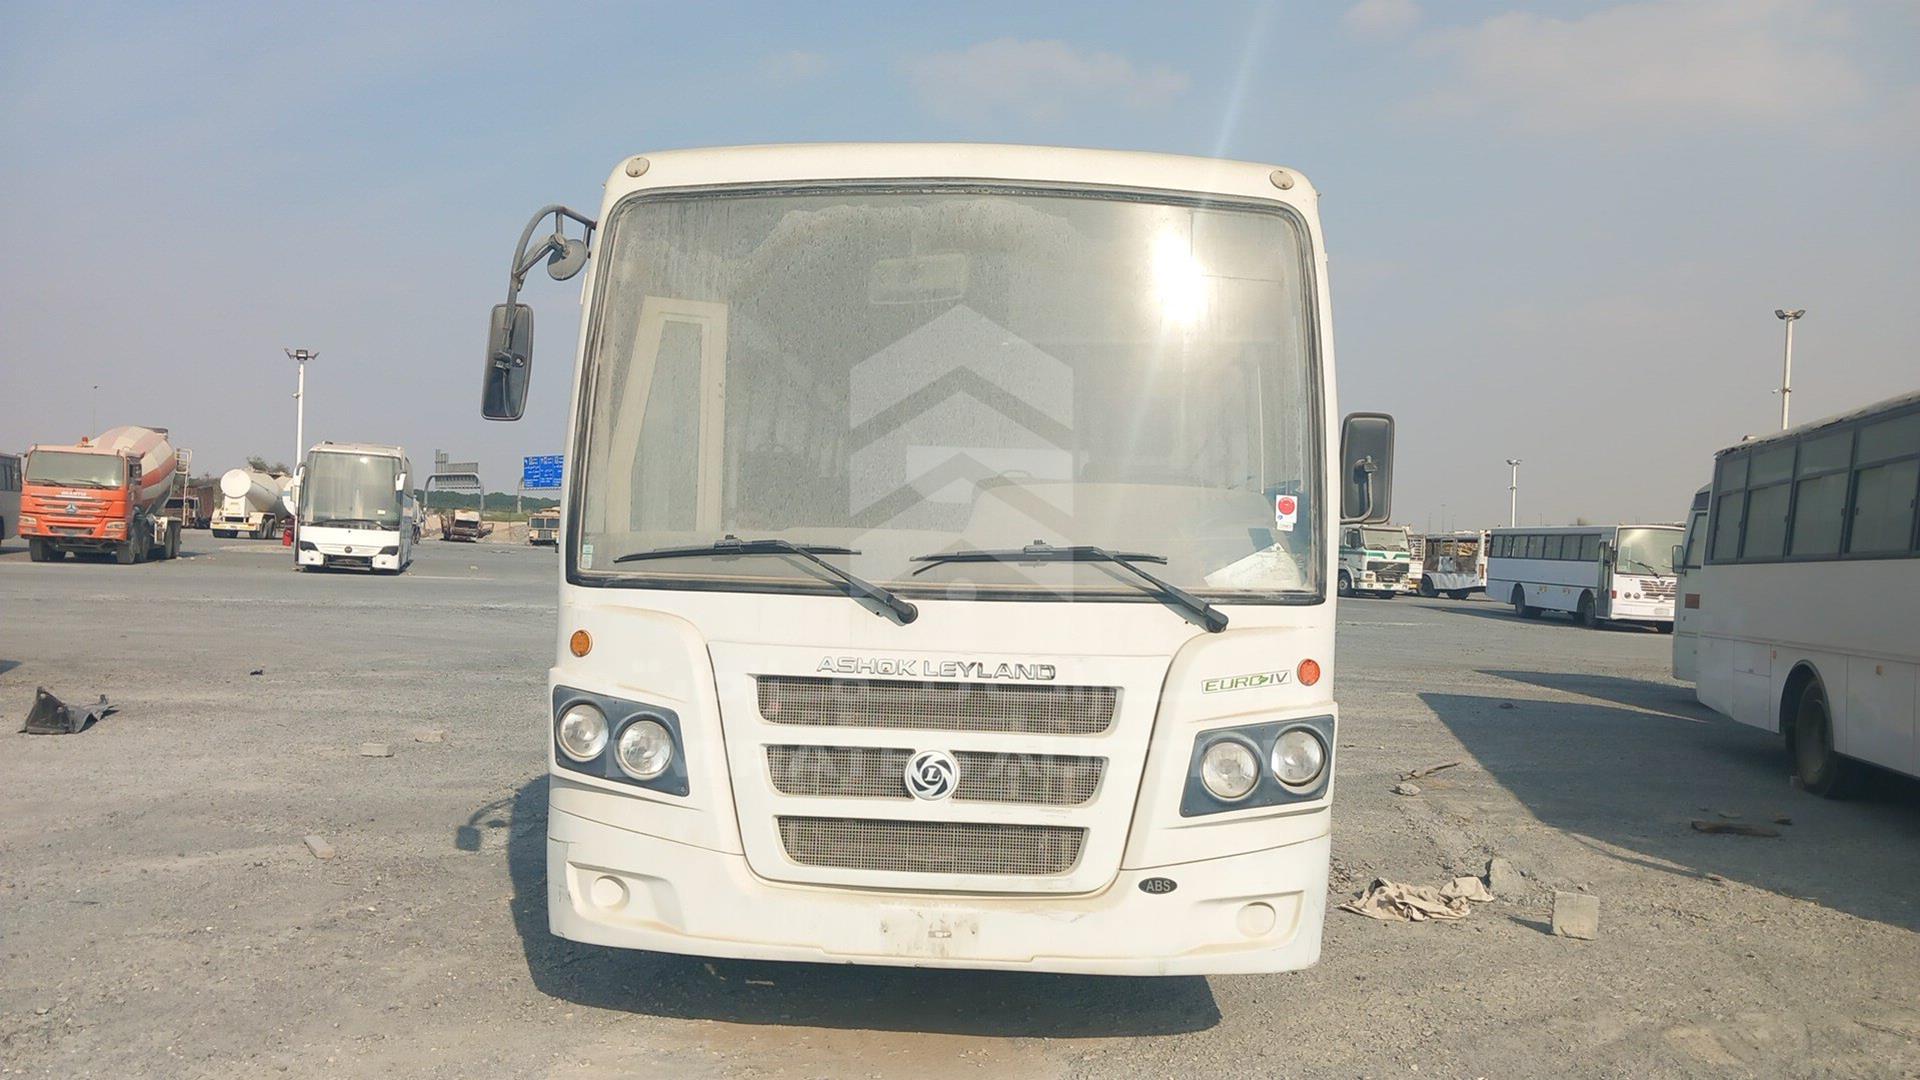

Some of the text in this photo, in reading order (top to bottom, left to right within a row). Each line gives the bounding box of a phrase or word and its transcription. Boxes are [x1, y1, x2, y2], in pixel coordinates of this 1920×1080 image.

[817, 656, 1056, 681] ASHOK LEYLAND
[924, 767, 941, 782] L
[1146, 880, 1171, 892] ABS
